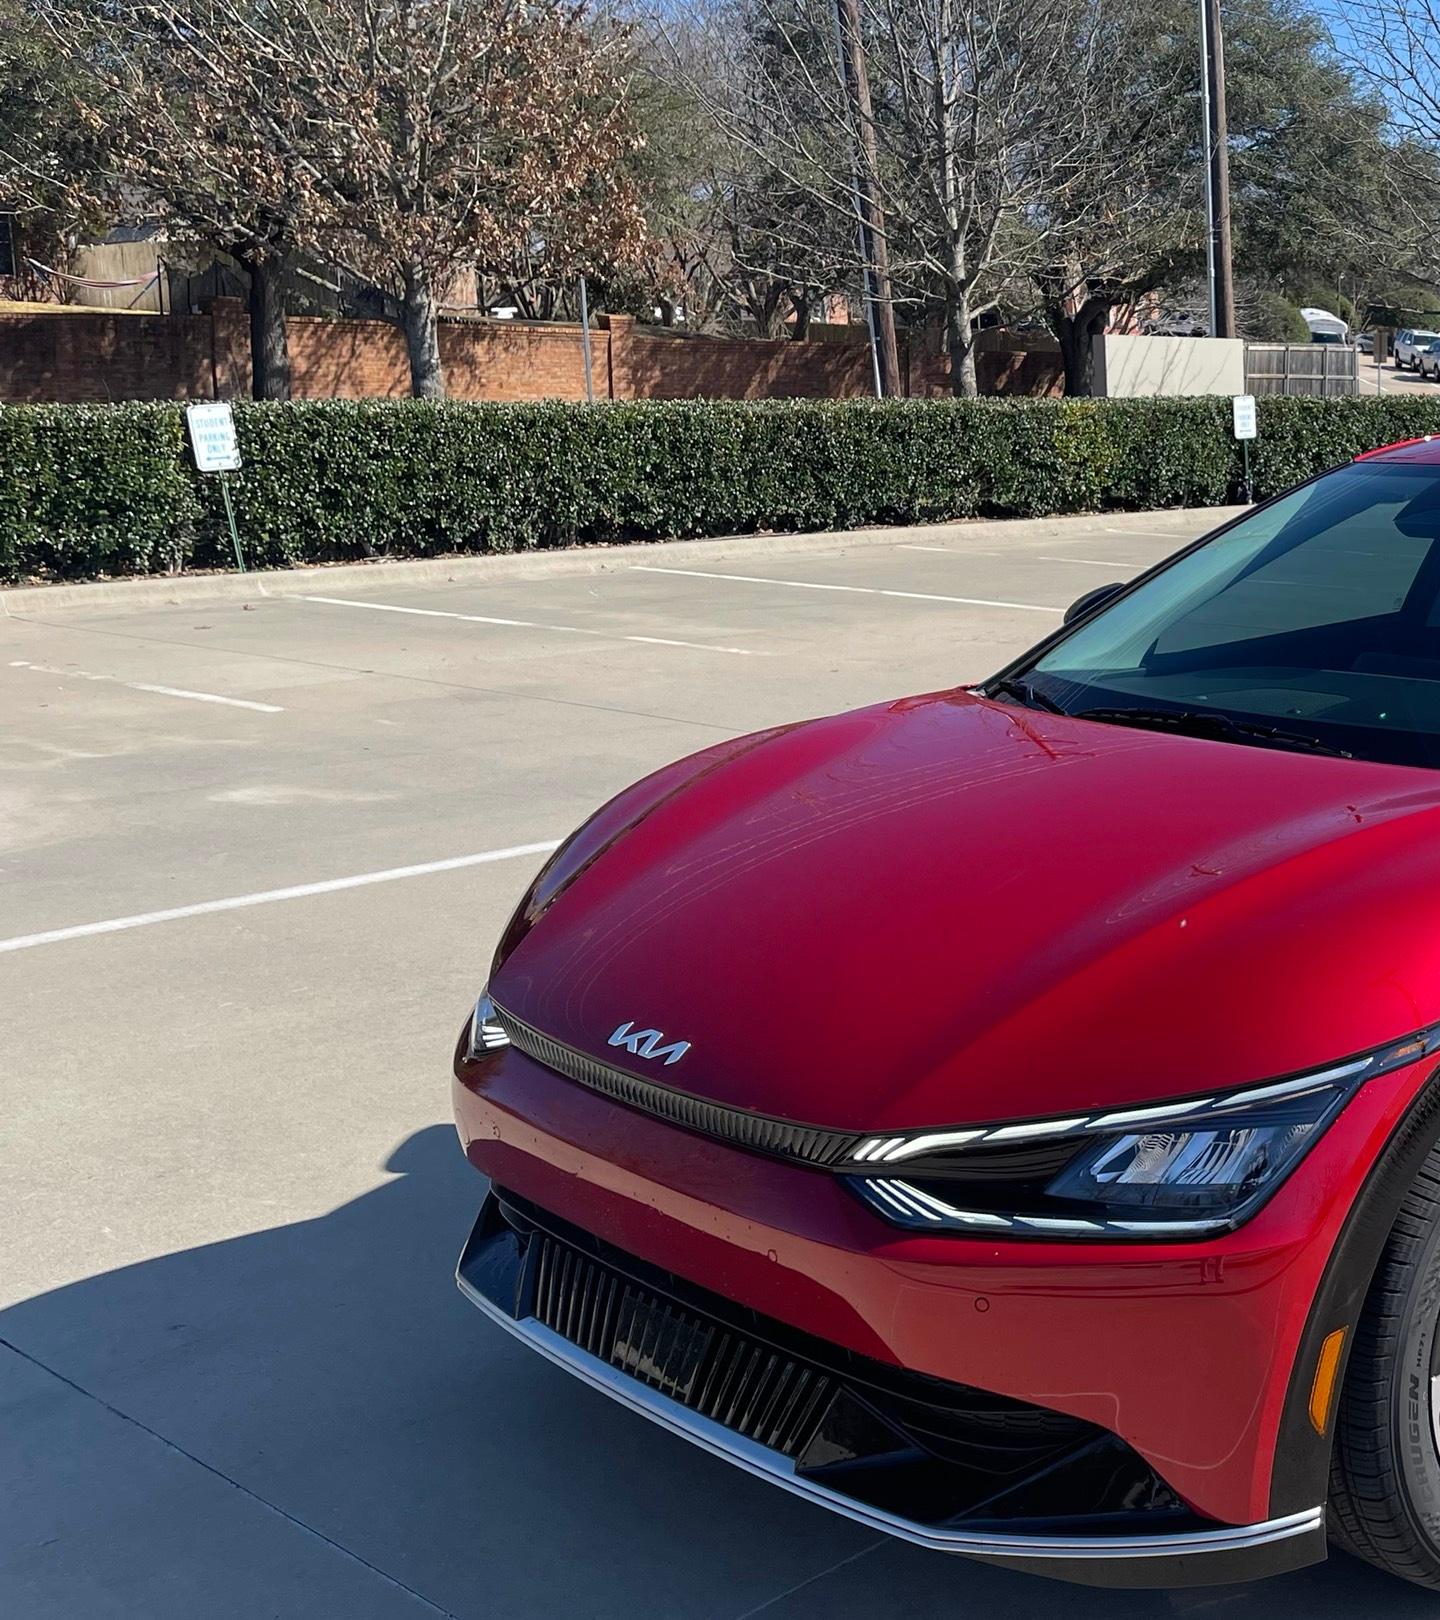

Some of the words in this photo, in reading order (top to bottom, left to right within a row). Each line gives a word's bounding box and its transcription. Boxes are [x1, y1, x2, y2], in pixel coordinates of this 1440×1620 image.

[195, 417, 228, 429] STUDENT
[199, 432, 231, 443] PARKING
[207, 444, 226, 454] ONLY
[607, 1021, 692, 1066] KIA
[1408, 1373, 1434, 1503] CRUGEN
